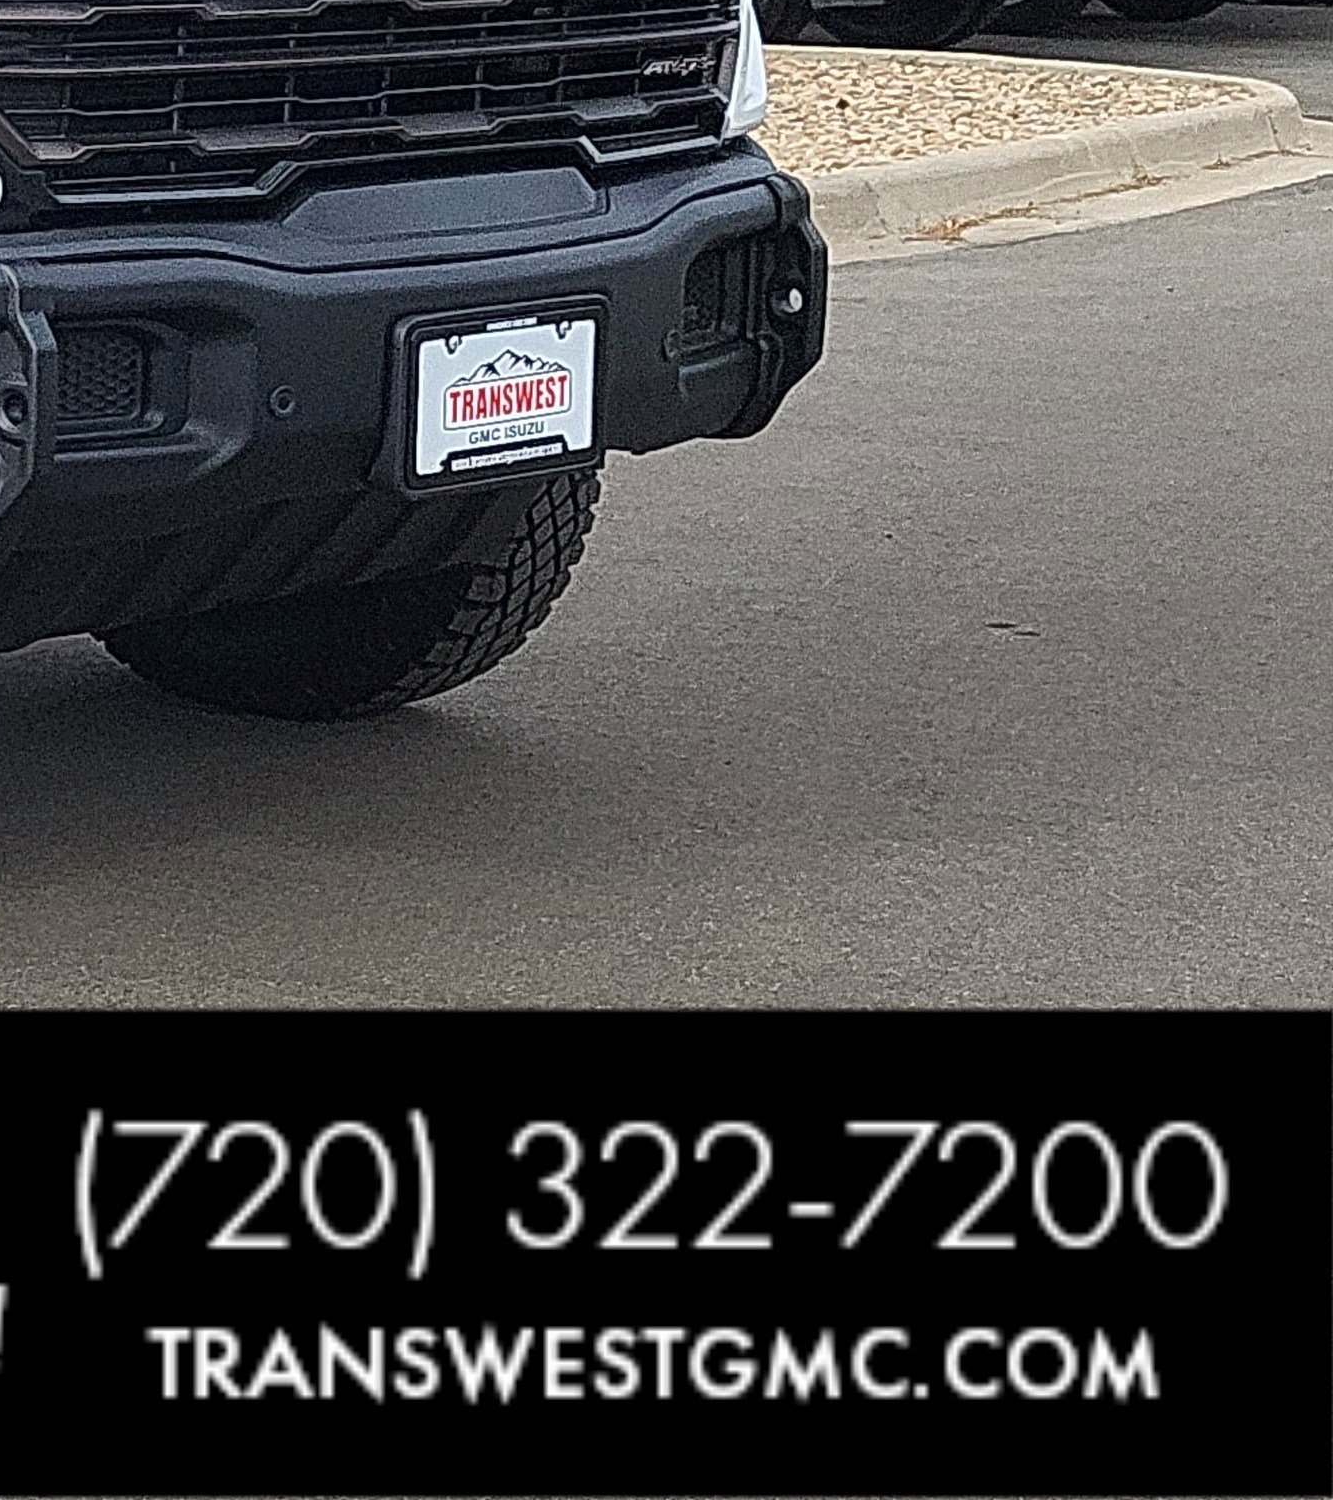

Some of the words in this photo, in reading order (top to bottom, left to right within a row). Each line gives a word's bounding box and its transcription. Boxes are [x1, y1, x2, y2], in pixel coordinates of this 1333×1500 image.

[449, 374, 568, 424] TRANSWEST
[468, 427, 501, 445] GMC
[504, 420, 545, 439] ISUZU
